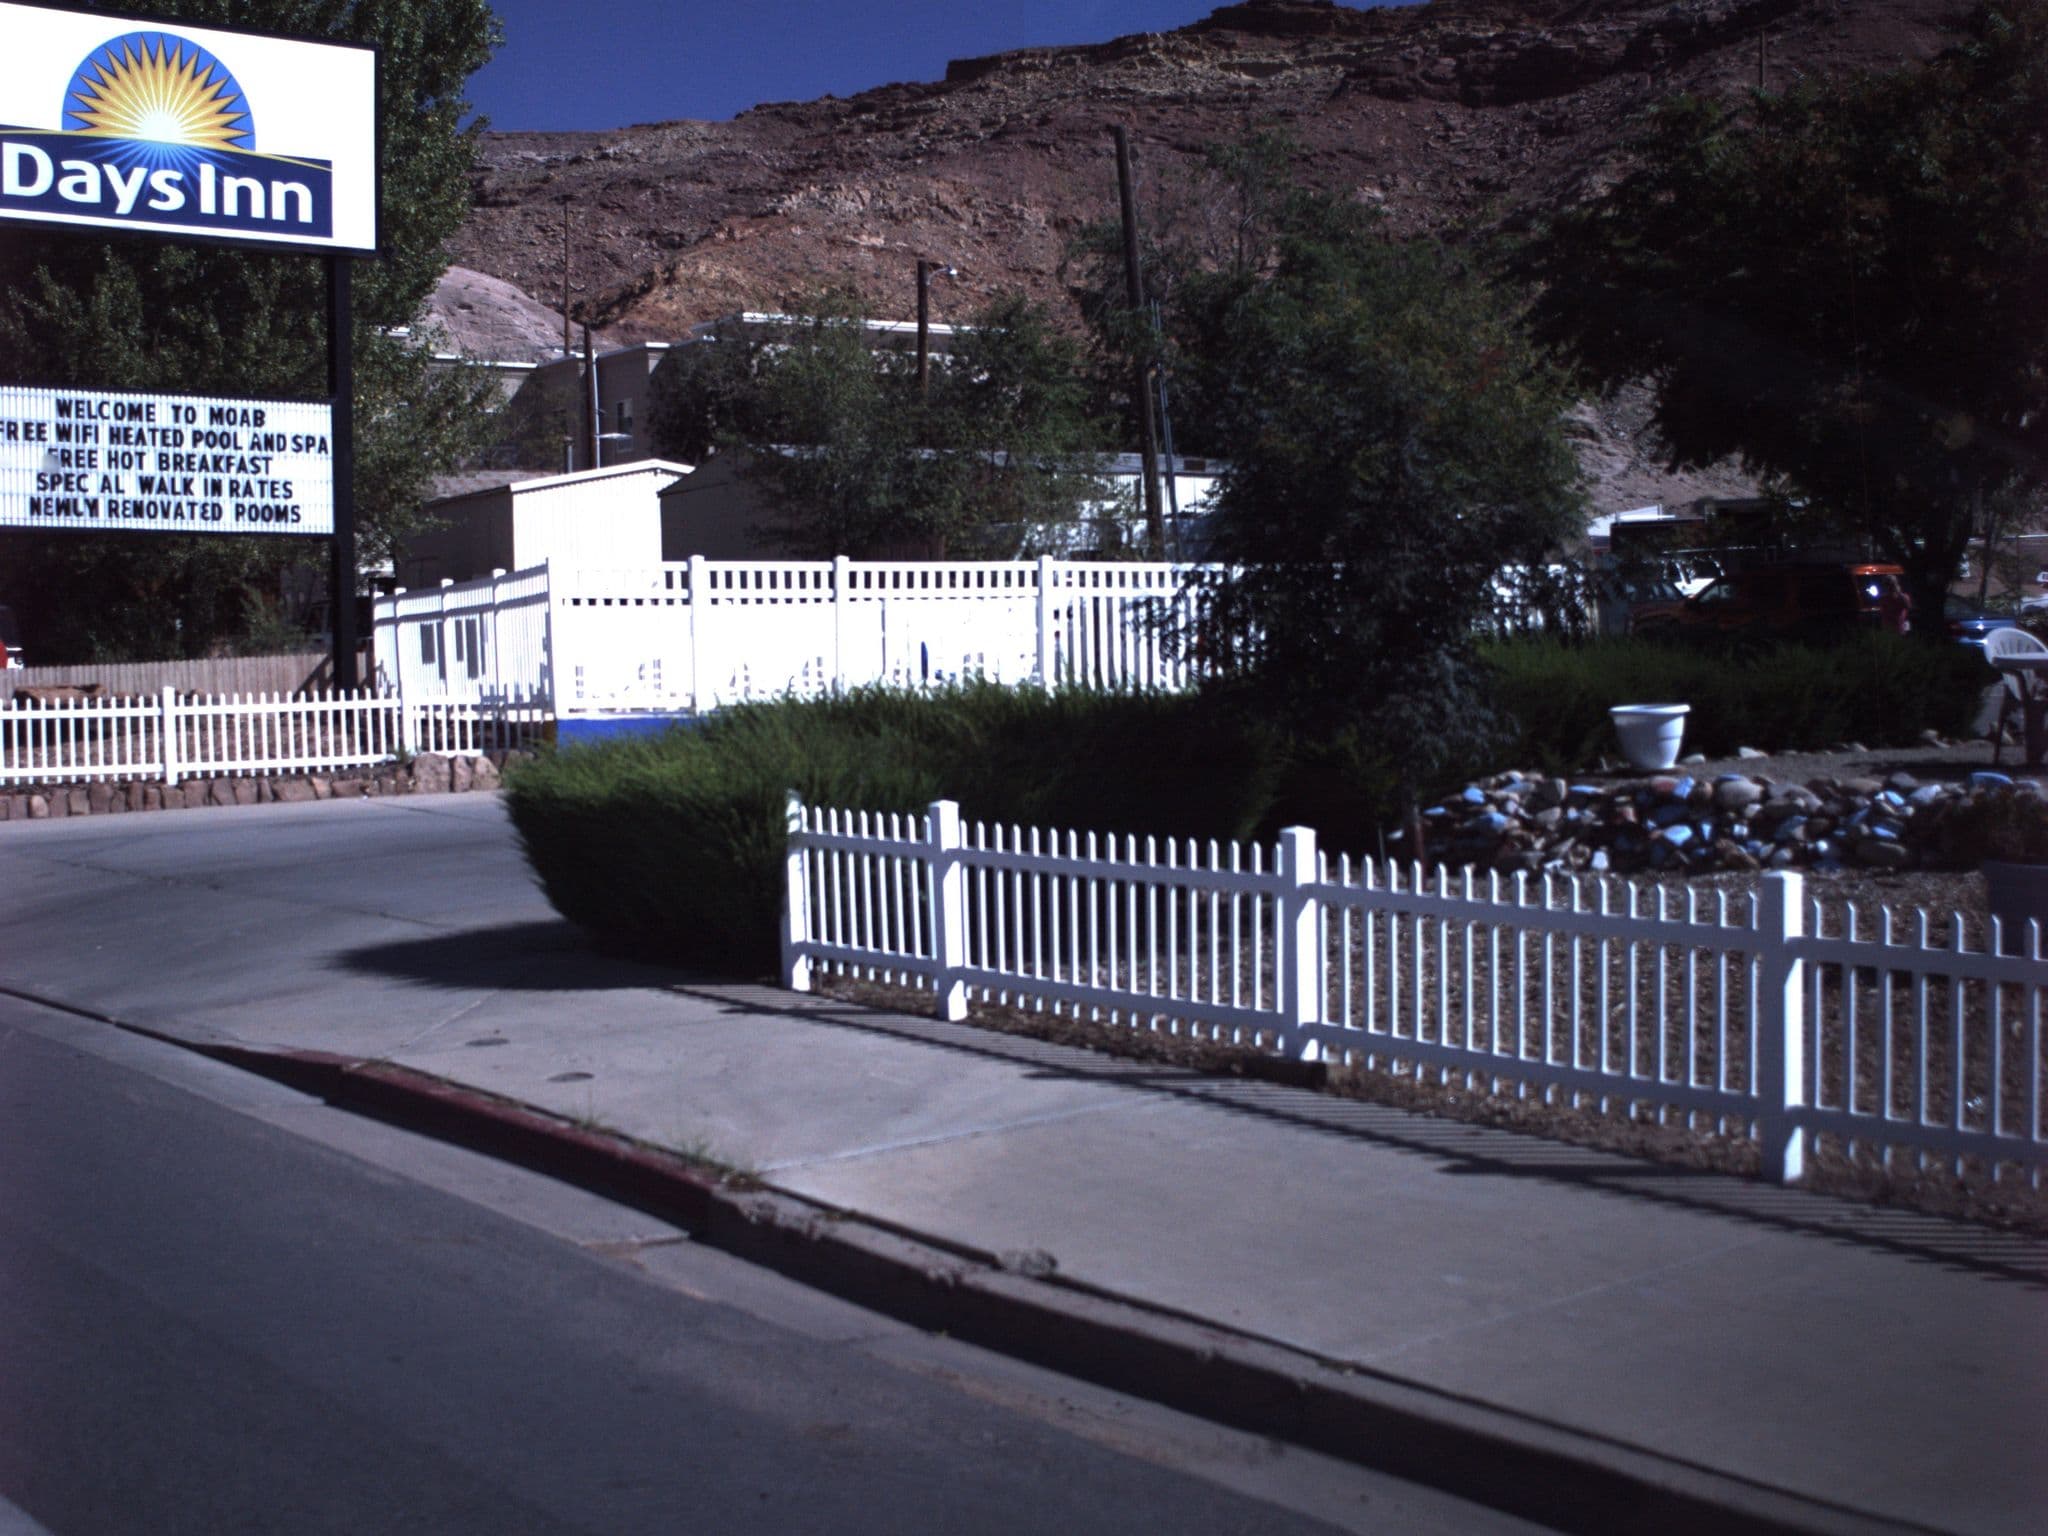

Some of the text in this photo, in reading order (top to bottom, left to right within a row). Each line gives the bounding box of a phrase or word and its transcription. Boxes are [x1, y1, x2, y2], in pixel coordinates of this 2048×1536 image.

[2, 142, 313, 224] Days Inn
[56, 400, 266, 428] WELCOME TO MOAB
[55, 424, 99, 444] WIFI
[109, 426, 184, 448] HEATED
[192, 430, 243, 451] POOL
[250, 434, 287, 452] AND
[291, 434, 329, 455] SPA
[107, 451, 147, 471] HOT
[158, 453, 273, 475] BREAKFAST
[139, 477, 194, 496] WALK
[203, 480, 223, 497] IN
[229, 480, 293, 500] RATES
[29, 496, 100, 517] NEWLY
[108, 499, 223, 522] RENOVATED
